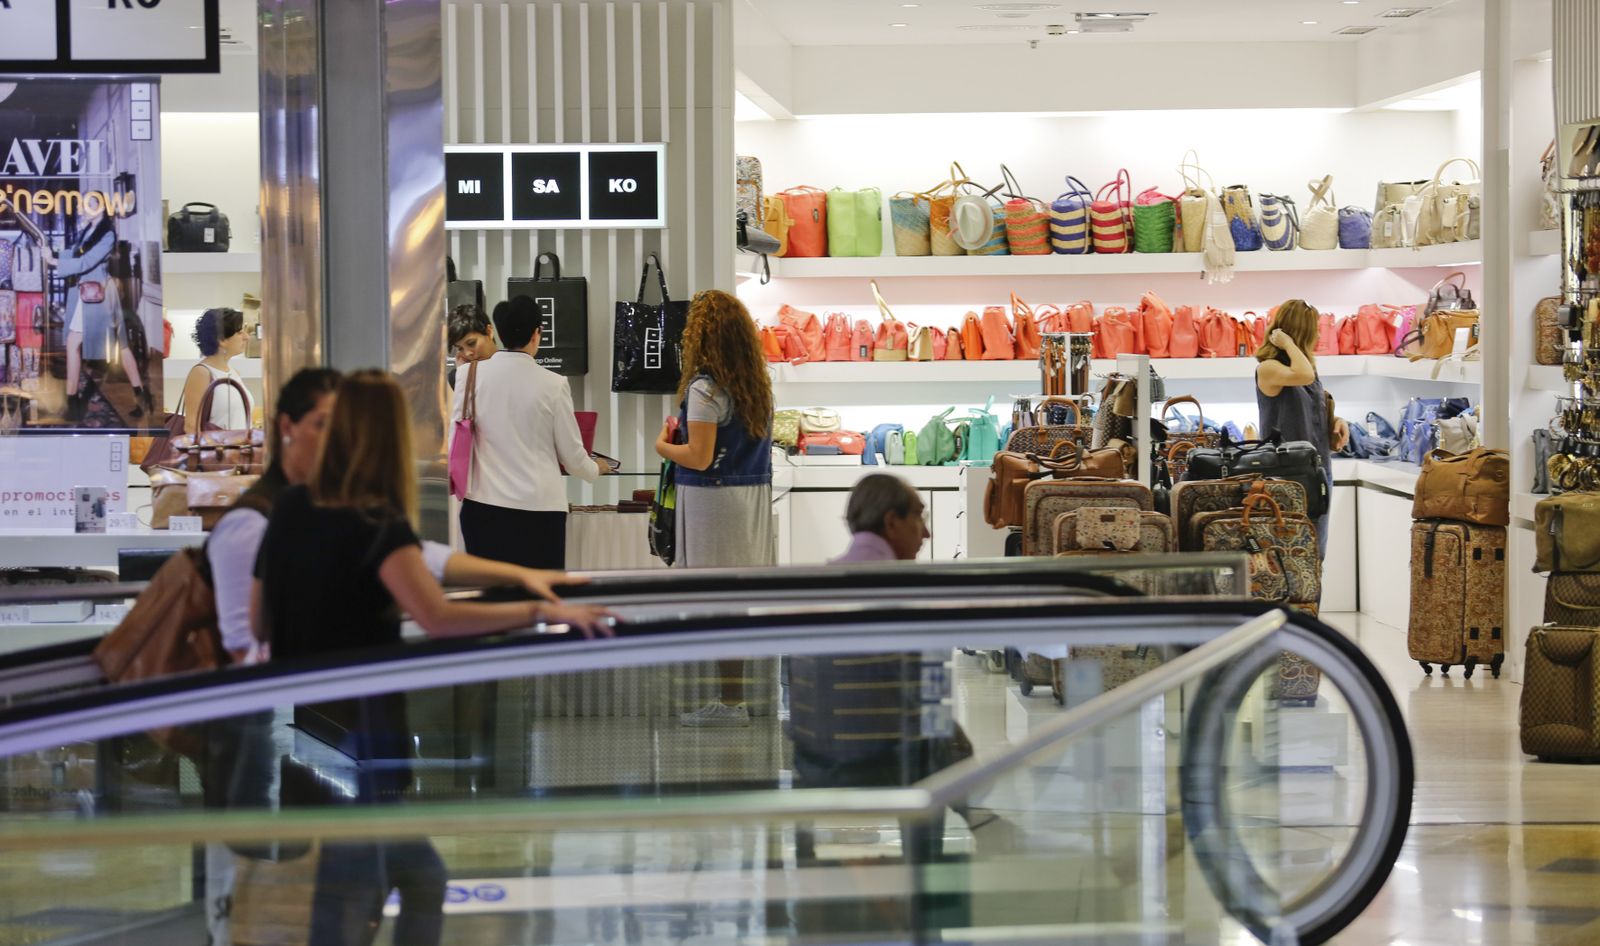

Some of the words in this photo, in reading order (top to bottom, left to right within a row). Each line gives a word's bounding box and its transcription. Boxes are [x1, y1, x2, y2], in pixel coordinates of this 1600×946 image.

[0, 137, 115, 176] AVEL
[458, 180, 481, 194] MI
[532, 179, 560, 194] SA
[608, 178, 637, 193] KO
[2, 489, 120, 503] promocies
[4, 508, 18, 516] en
[28, 508, 41, 516] el
